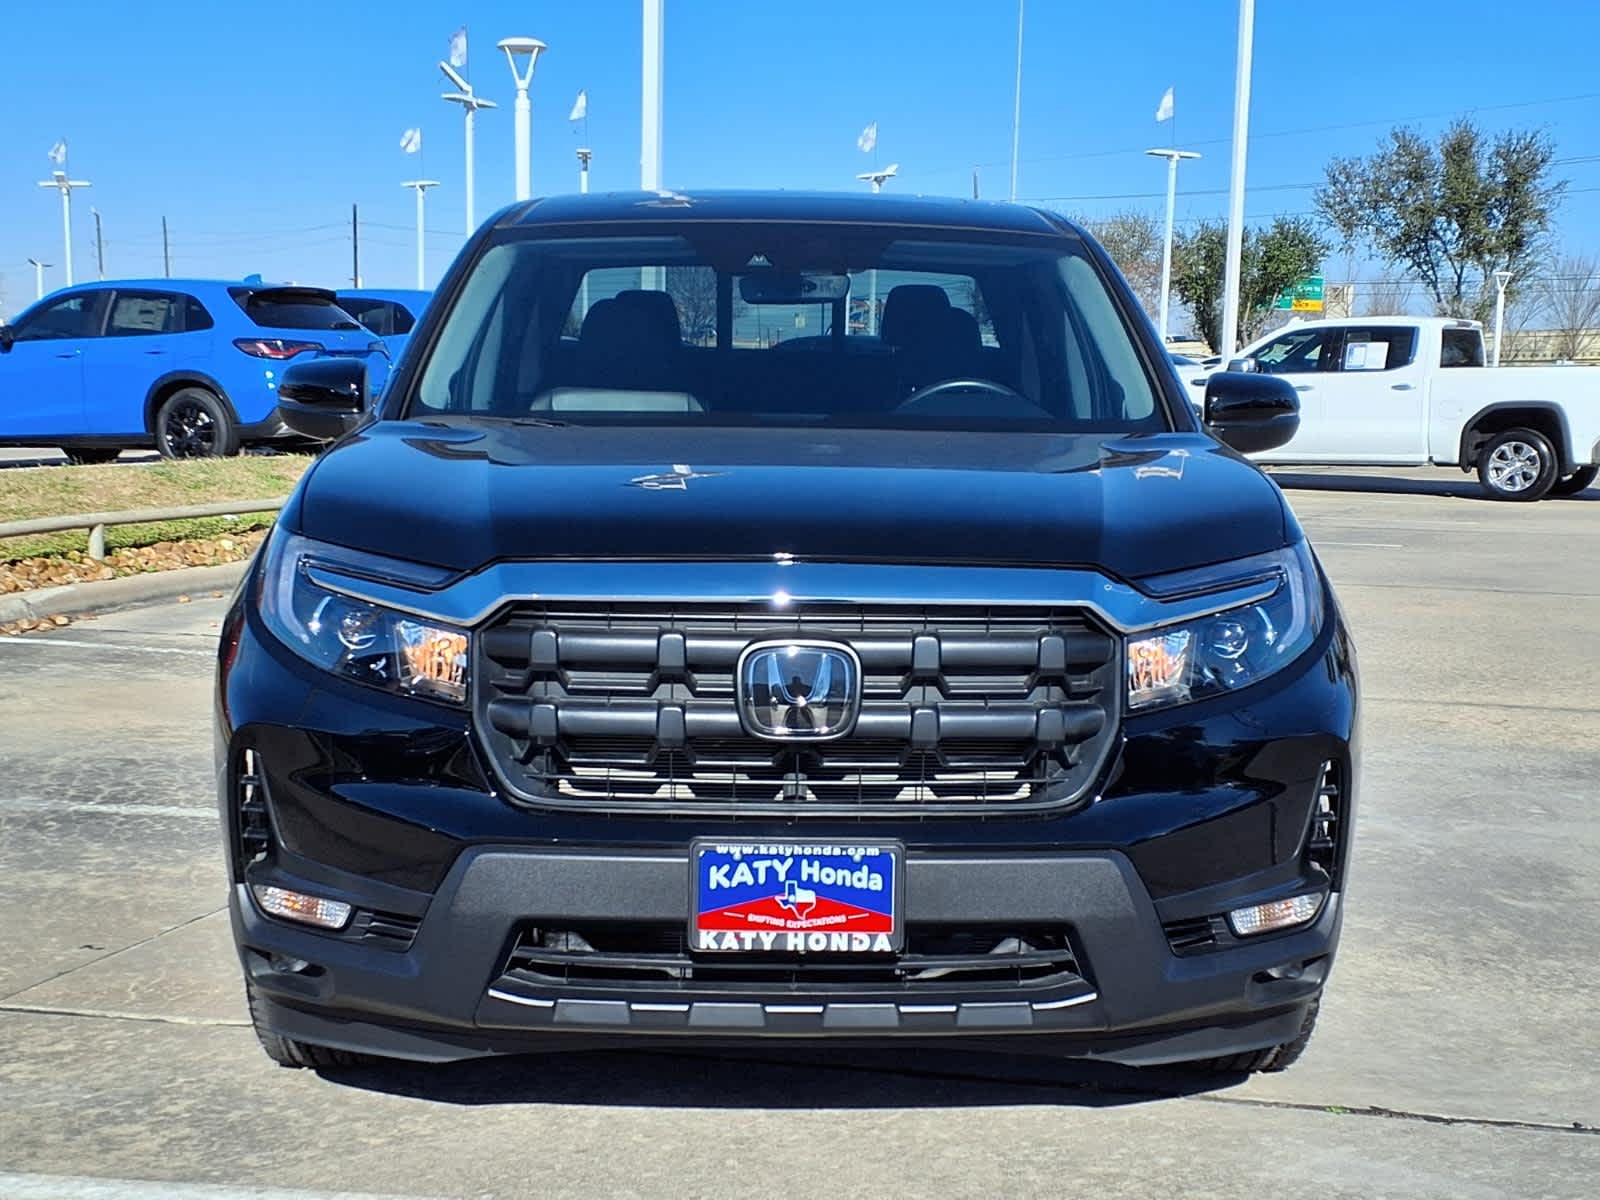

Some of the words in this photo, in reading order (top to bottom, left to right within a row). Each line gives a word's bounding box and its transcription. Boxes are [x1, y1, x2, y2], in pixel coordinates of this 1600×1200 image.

[709, 857, 793, 889] KATY
[801, 859, 883, 891] Honda
[699, 931, 776, 950] KATY
[786, 932, 892, 952] HONDA
